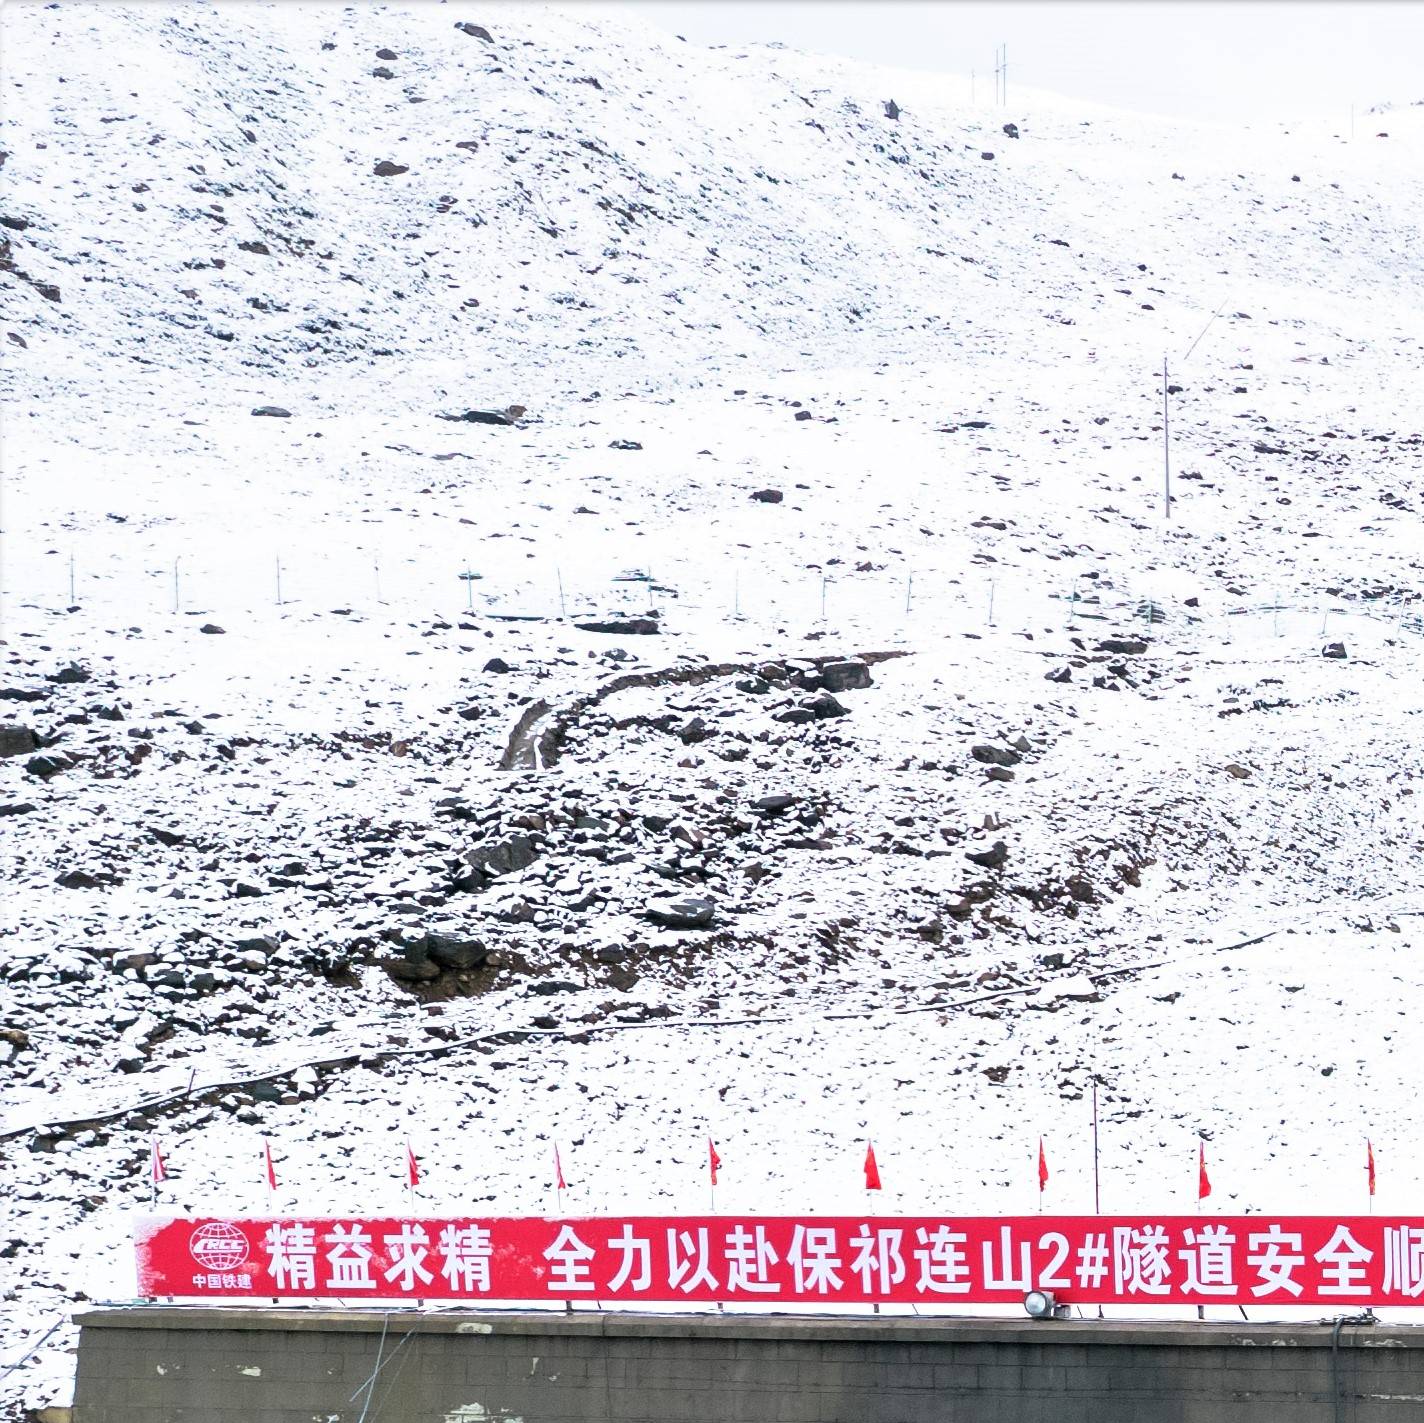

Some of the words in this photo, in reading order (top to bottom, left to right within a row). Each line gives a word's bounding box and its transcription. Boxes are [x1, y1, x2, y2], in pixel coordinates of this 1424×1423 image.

[265, 1223, 493, 1292] 精益求精
[192, 1273, 252, 1289] 中国铁建
